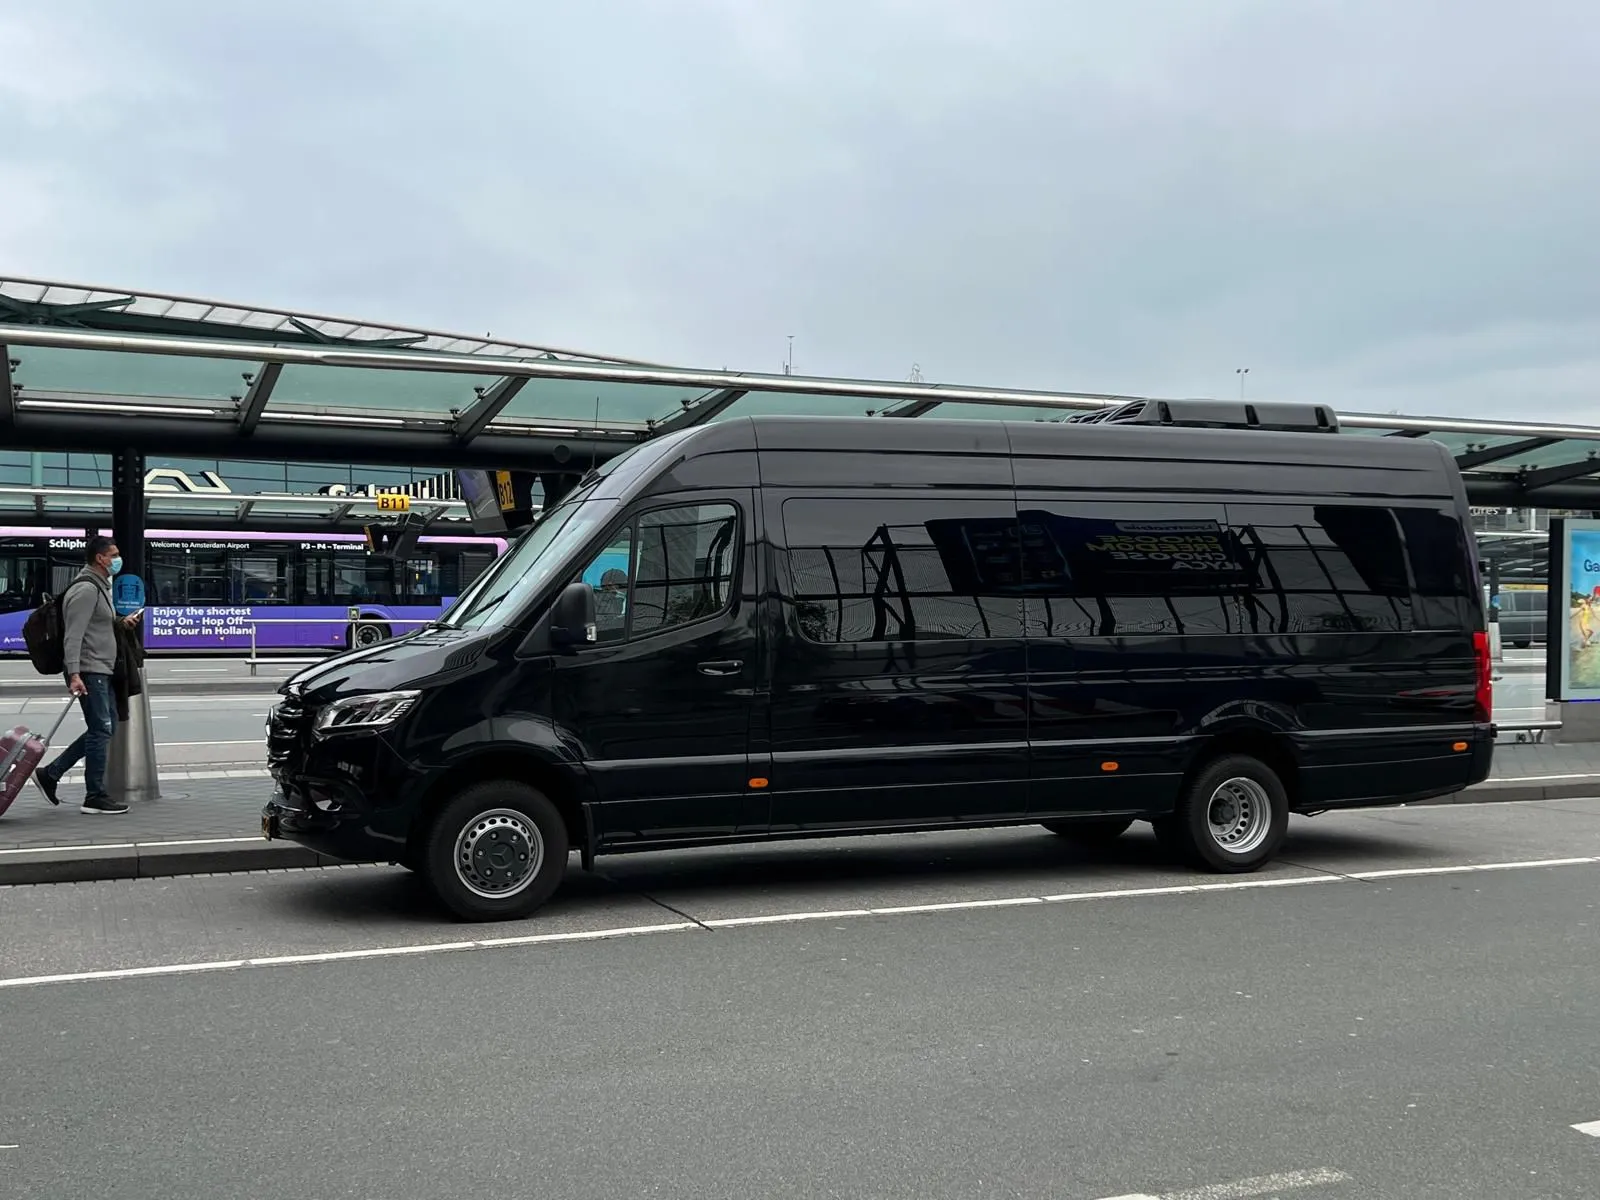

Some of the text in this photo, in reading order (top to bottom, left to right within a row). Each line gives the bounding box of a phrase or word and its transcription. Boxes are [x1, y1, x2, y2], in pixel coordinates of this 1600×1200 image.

[381, 498, 406, 509] B11
[150, 541, 181, 549] Welcome
[189, 541, 226, 549] Amsterdam
[227, 542, 250, 550] Airport
[153, 607, 252, 618] Enjoy the shortest
[153, 617, 176, 627] Hop
[177, 616, 194, 626] On
[202, 617, 224, 627] Hop
[226, 616, 244, 626] Off
[153, 627, 173, 636] Bus
[174, 627, 200, 636] Tour
[201, 626, 213, 636] in
